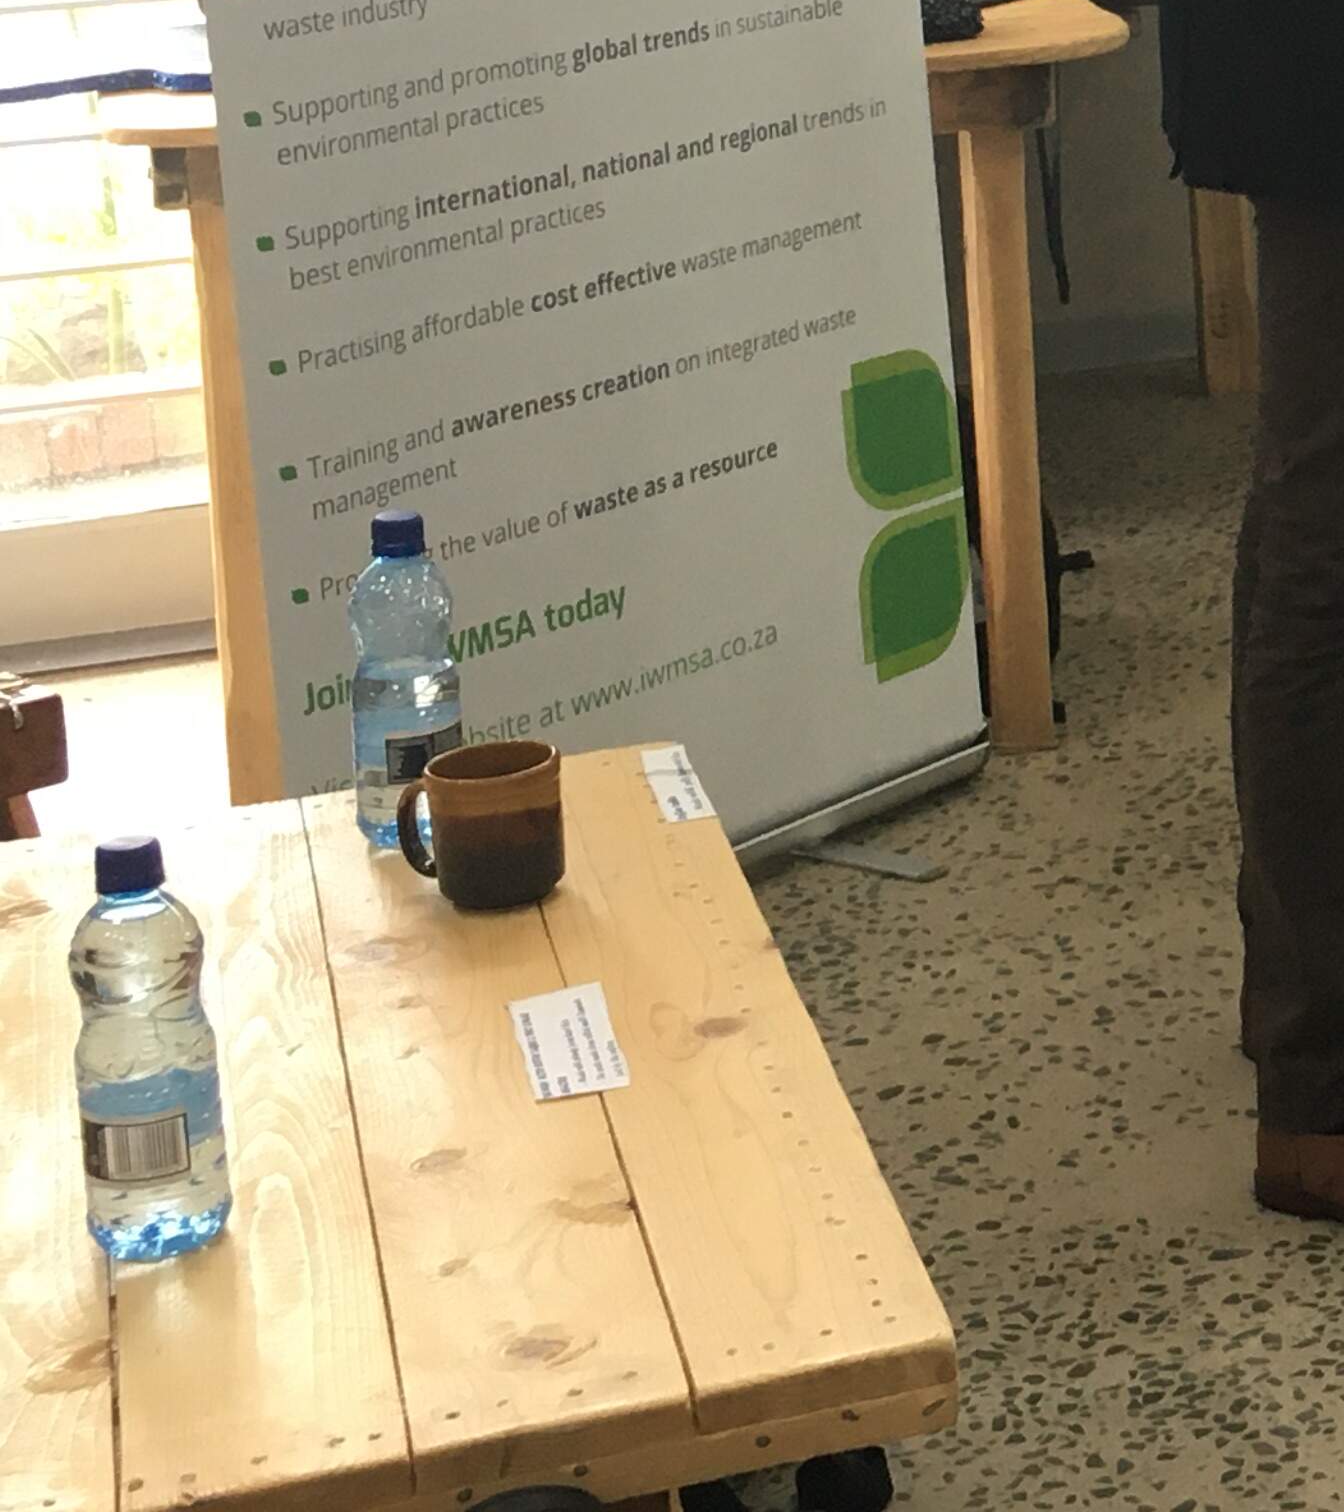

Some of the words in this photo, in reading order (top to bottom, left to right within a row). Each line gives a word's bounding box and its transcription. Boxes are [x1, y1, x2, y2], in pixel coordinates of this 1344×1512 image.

[298, 329, 407, 373] Practising
[412, 297, 524, 343] affordable
[531, 283, 579, 312] cost
[584, 261, 676, 299] effective
[682, 246, 737, 274] waste
[742, 212, 862, 258] management
[543, 586, 626, 631] today
[539, 700, 565, 728] at
[571, 625, 777, 716] www.iwmsa.co.za
